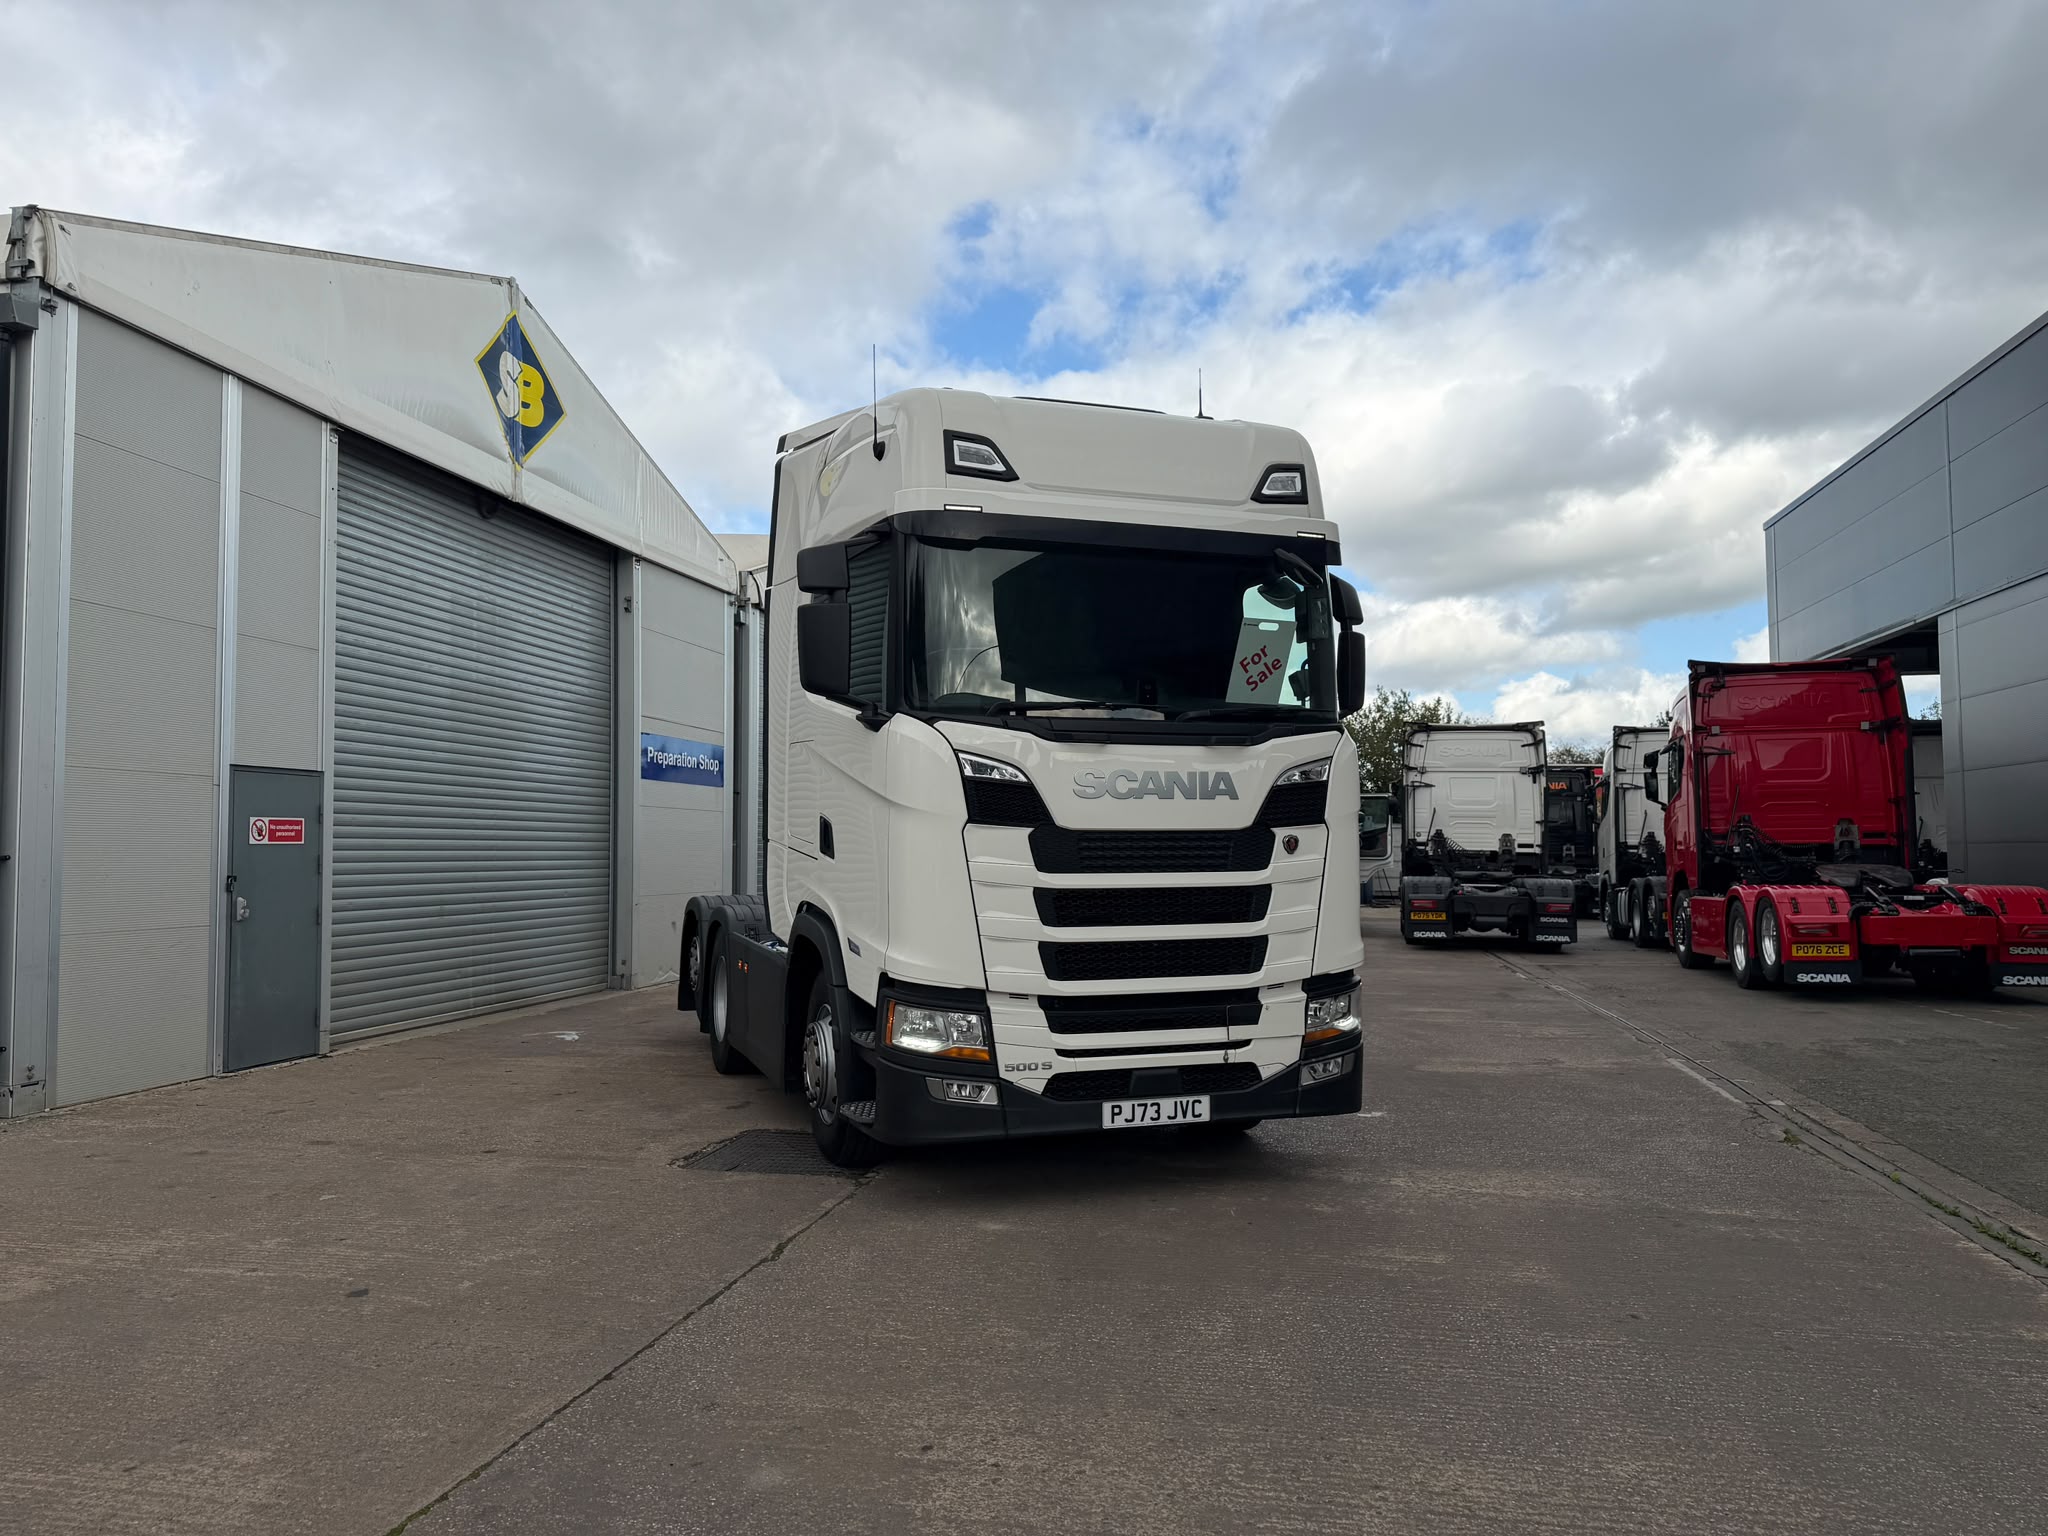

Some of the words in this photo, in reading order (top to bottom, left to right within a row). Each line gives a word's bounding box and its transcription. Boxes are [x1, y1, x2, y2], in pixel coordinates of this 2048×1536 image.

[1239, 645, 1268, 674] For
[1245, 658, 1282, 692] Sale
[647, 746, 697, 769] Preparation
[699, 754, 720, 775] Shop
[1072, 768, 1240, 800] SCANIA
[1548, 781, 1568, 790] NIA
[1413, 930, 1447, 938] SCANIA
[1535, 934, 1571, 942] SCANIA
[1796, 945, 1823, 954] PO76
[1825, 945, 1845, 954] ZCE
[2009, 946, 2048, 955] SCANI
[1796, 973, 1851, 983] SCANIA
[2002, 975, 2048, 985] SCANI
[1004, 1062, 1039, 1072] 500
[1041, 1061, 1052, 1070] S
[1110, 1101, 1161, 1124] PJ73
[1166, 1099, 1203, 1120] JVC
